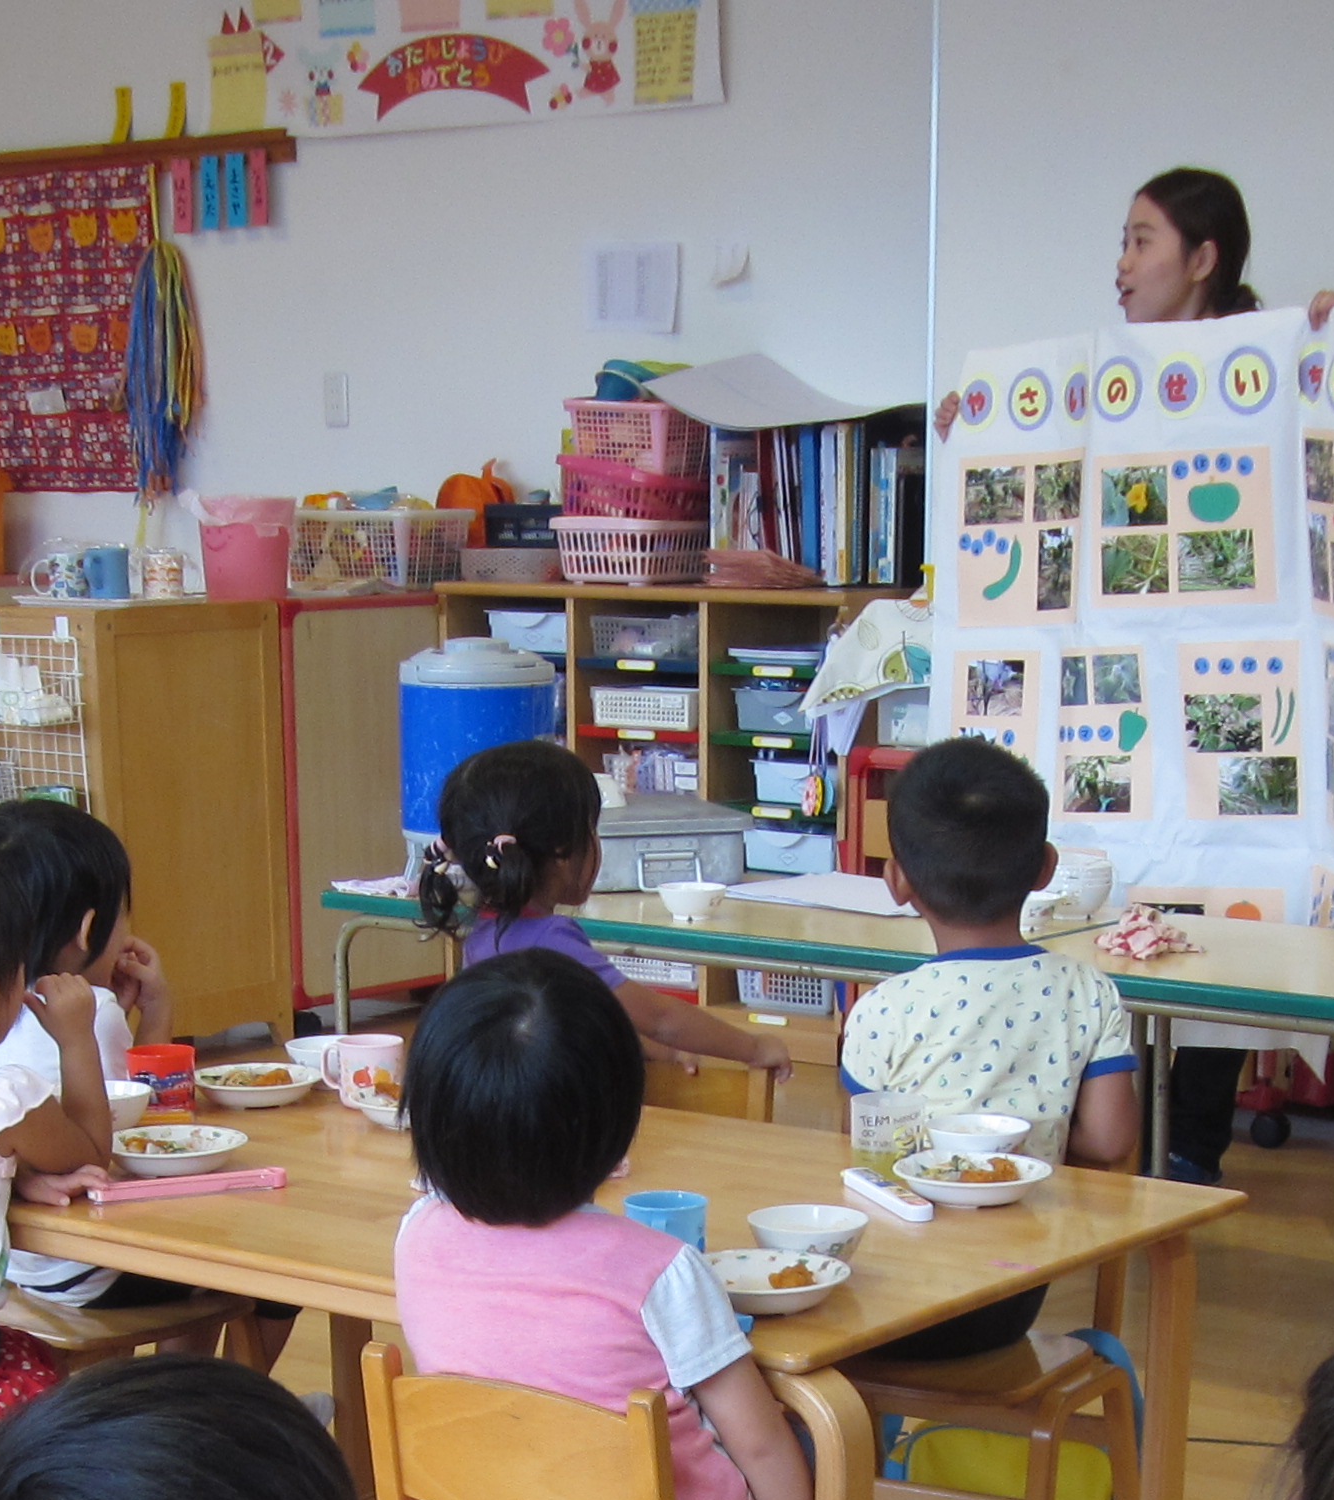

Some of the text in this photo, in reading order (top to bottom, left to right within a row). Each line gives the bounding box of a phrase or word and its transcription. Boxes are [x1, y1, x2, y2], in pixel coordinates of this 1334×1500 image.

[385, 35, 512, 77] おたんじょうび
[405, 61, 492, 93] おめでとう
[859, 1115, 891, 1128] TEAM
